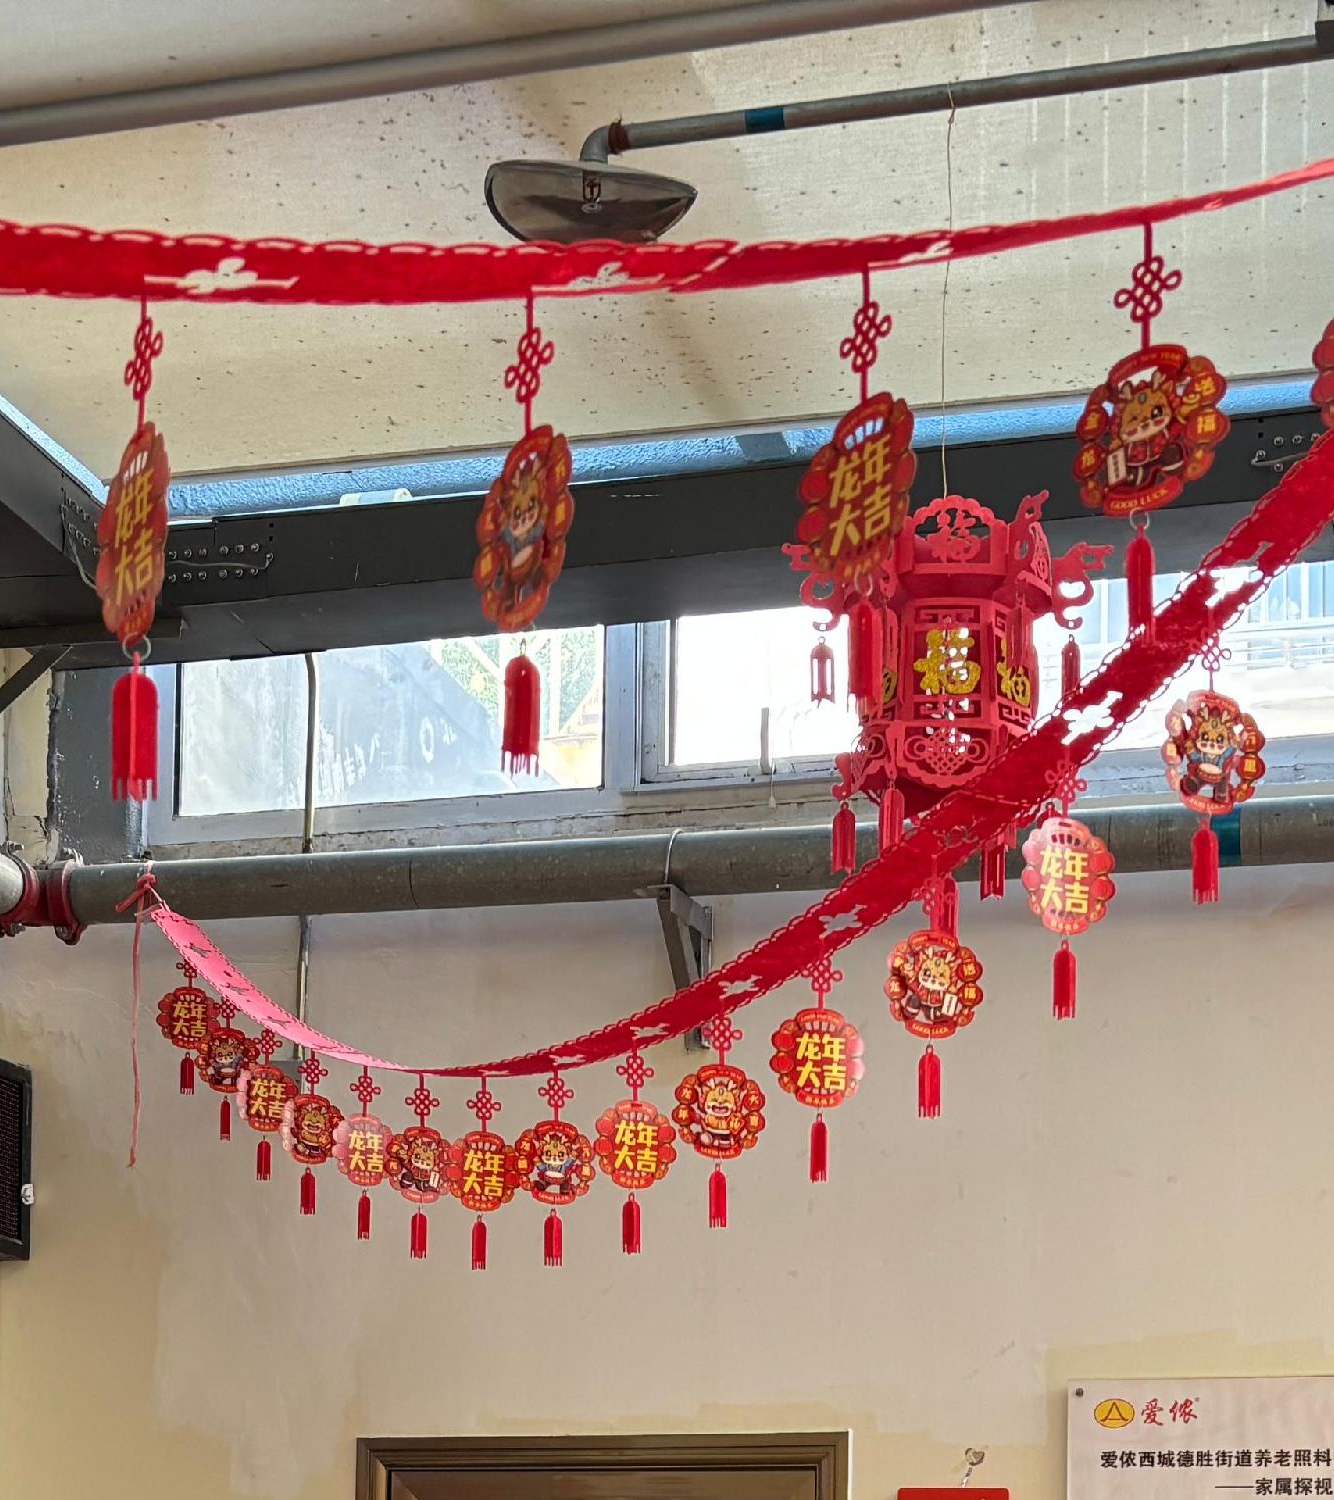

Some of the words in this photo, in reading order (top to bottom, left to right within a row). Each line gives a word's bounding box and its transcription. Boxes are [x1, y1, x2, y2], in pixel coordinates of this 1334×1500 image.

[828, 434, 893, 508] 龙年
[829, 483, 893, 557] 大吉
[1040, 847, 1090, 881] 龙年
[1040, 878, 1090, 915] 大吉
[172, 1001, 208, 1019] 龙年
[172, 1020, 208, 1038] 大吉
[796, 1032, 847, 1063] 龙年
[250, 1077, 287, 1098] 龙年
[796, 1063, 848, 1091] 大吉
[250, 1098, 285, 1118] 大吉
[347, 1129, 384, 1151] 龙年
[614, 1120, 659, 1147] 龙年
[348, 1151, 385, 1172] 大吉
[463, 1149, 505, 1174] 龙年
[614, 1146, 659, 1173] 大吉
[463, 1174, 504, 1198] 大吉
[1140, 1397, 1199, 1426] 爱侬
